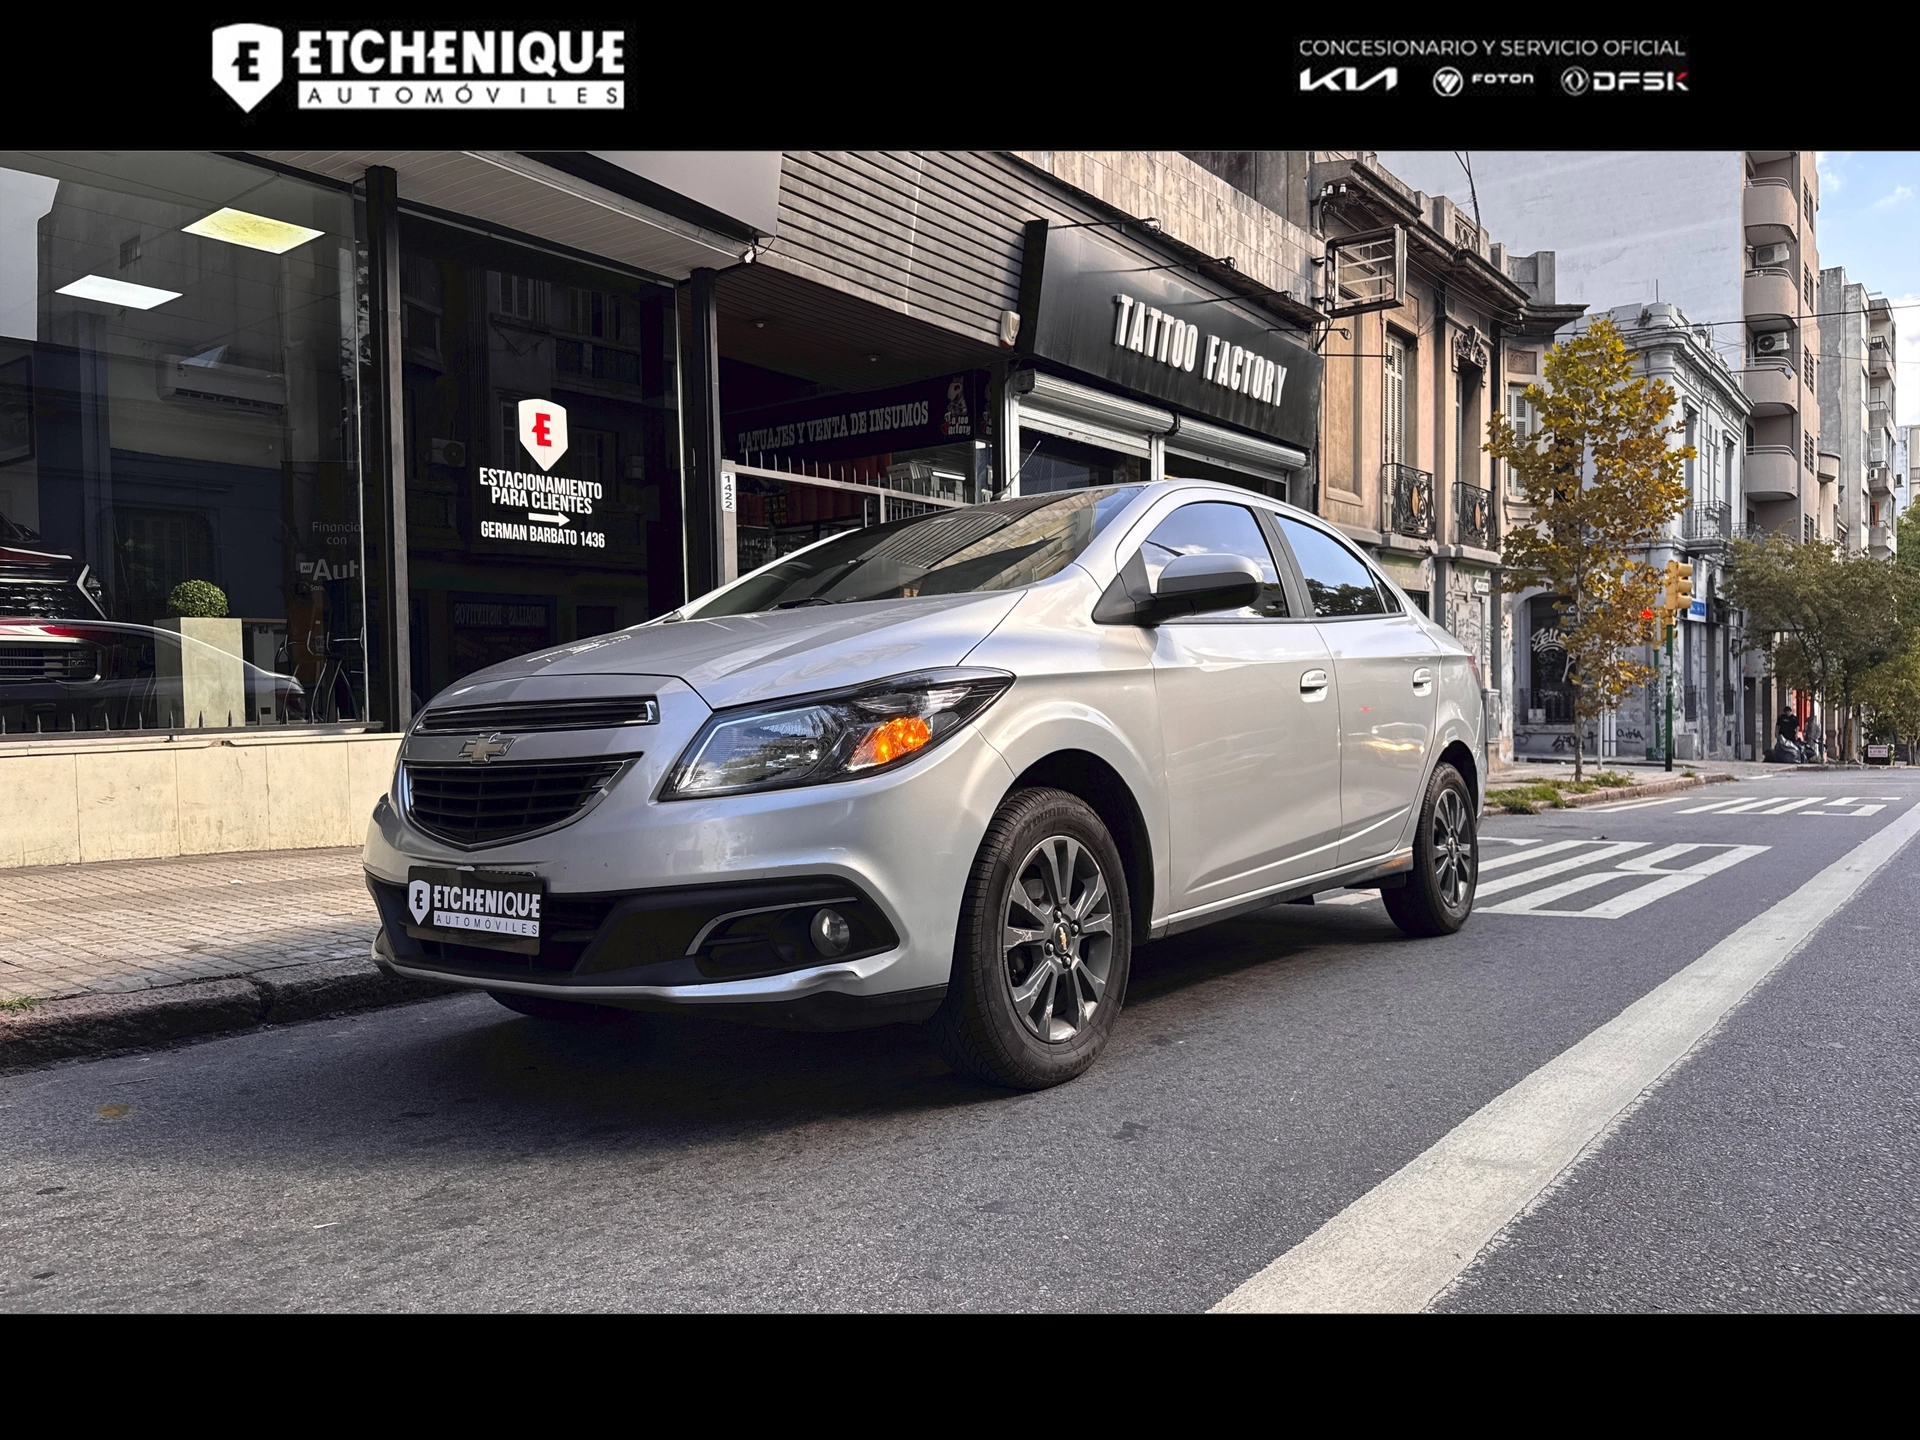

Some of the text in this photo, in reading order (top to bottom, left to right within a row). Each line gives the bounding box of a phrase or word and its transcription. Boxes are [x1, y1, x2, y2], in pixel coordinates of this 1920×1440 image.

[1114, 294, 1288, 407] TATTOO FACTORY
[738, 401, 929, 454] TATUAJES Y VENTA DE INSUMOS
[479, 467, 603, 500] ESTACIONAMIENTO
[723, 475, 734, 510] 1422
[491, 486, 593, 515] PARA CLIENTES
[326, 536, 347, 546] con
[480, 520, 606, 549] GERMAN BARBATO 1436
[312, 558, 362, 581] Aut
[433, 885, 541, 918] ETCHENIQUE
[436, 914, 538, 935] AUTOMÓVILES
